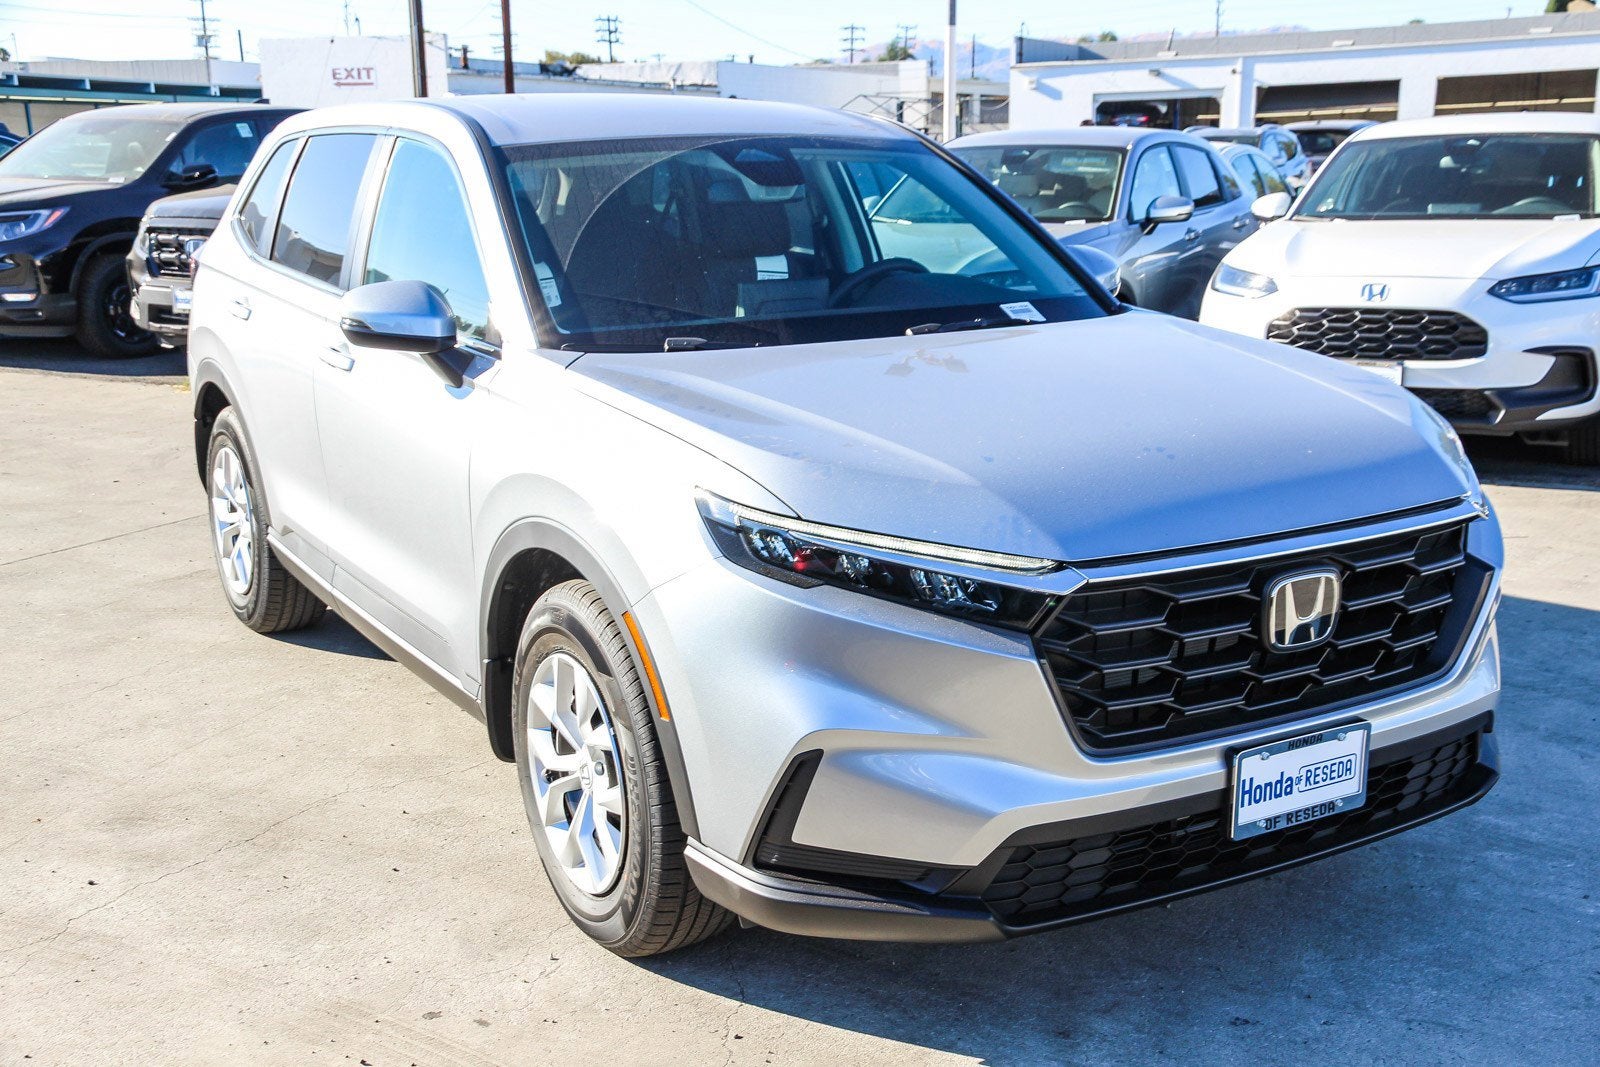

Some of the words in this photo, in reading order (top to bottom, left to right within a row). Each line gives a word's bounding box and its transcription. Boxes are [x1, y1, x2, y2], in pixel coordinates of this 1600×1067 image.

[331, 67, 374, 80] EXIT
[1287, 733, 1323, 750] HONDA
[1240, 771, 1293, 808] Honda
[1304, 759, 1352, 787] RESEDA
[1265, 819, 1281, 831] OF
[1286, 800, 1336, 826] RESEDA
